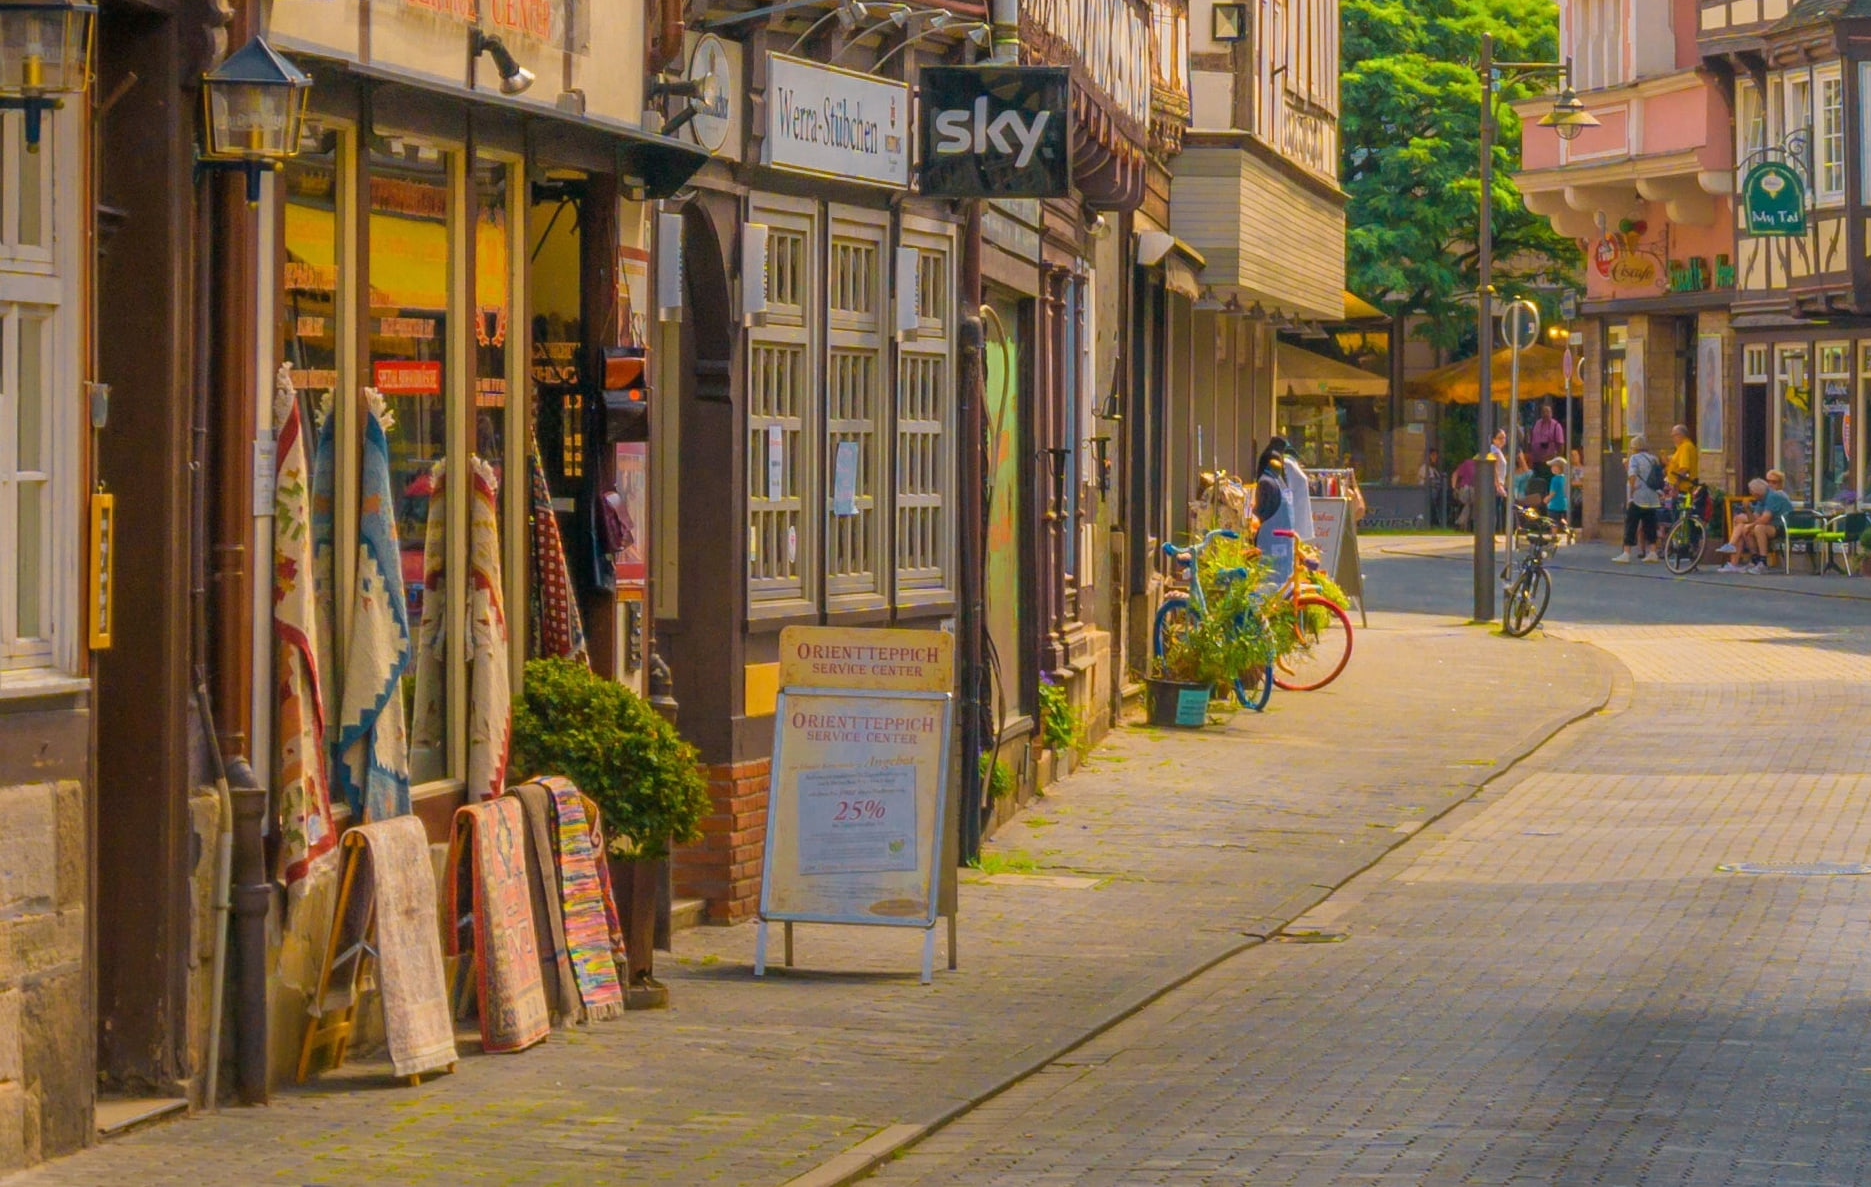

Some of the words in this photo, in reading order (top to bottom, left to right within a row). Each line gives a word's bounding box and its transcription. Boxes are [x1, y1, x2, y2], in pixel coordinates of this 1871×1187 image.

[777, 86, 879, 155] Werra-Stübchen
[935, 95, 1050, 168] sky
[797, 643, 939, 663] ORIENTTEPPICH
[812, 663, 867, 675] SERVICE
[871, 665, 923, 677] CENTER
[792, 712, 934, 732] ORIENTTEPPICH
[807, 731, 861, 742] SERVICE
[866, 732, 918, 745] CENTER
[833, 799, 886, 822] 25%
